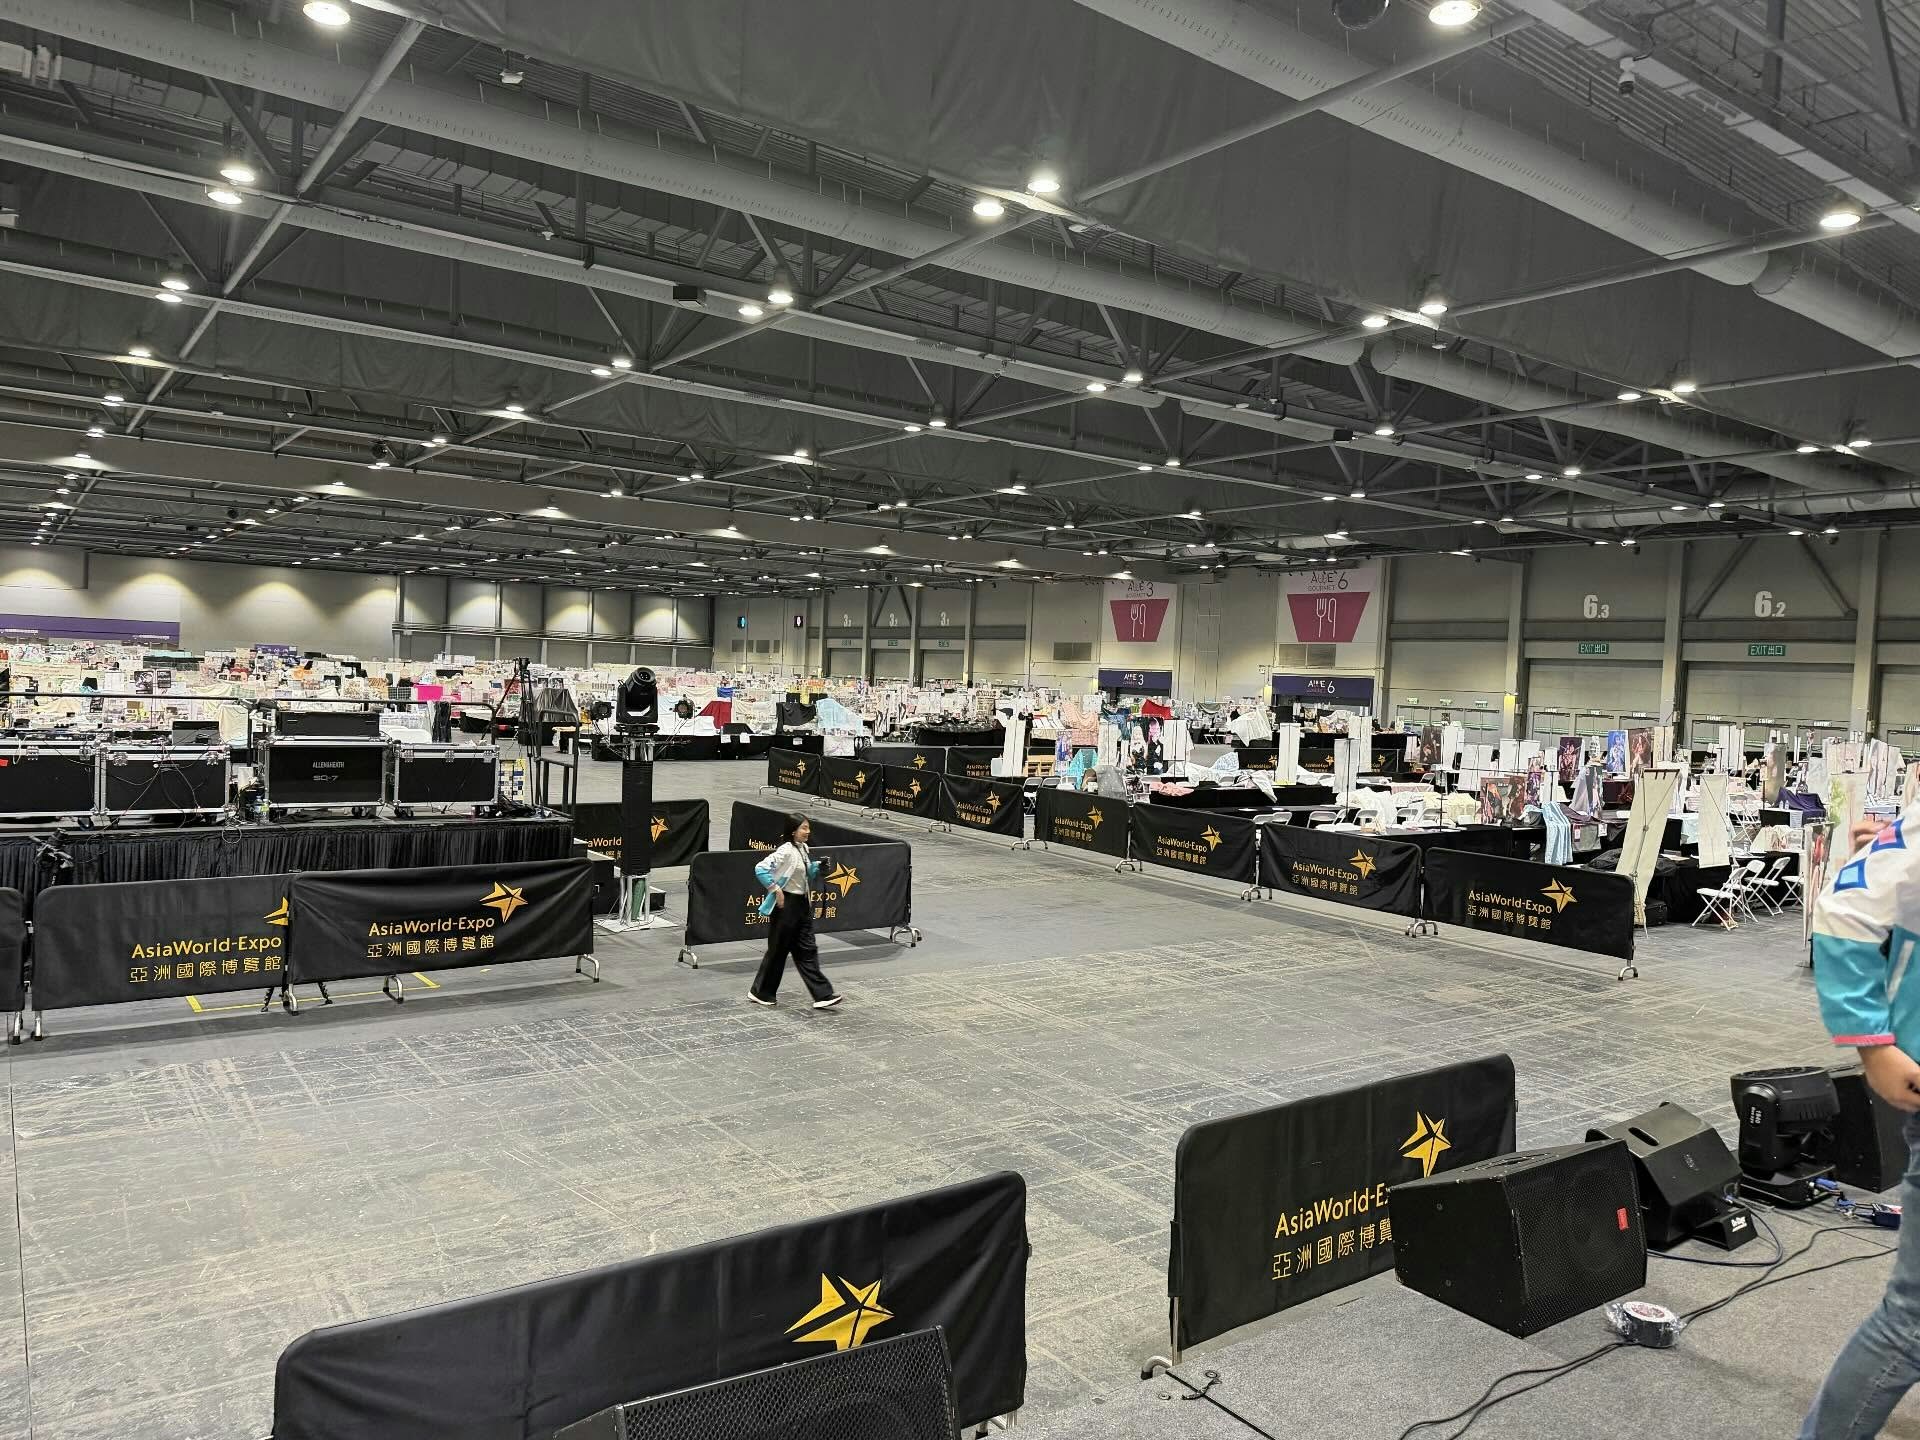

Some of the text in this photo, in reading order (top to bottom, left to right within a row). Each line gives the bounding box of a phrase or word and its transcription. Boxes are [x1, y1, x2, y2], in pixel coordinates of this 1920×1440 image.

[1146, 581, 1154, 597] 3
[1338, 571, 1349, 590] 6
[1583, 594, 1610, 619] 6.3
[1754, 590, 1786, 618] 6.2
[1580, 643, 1607, 653] EXIT 出口
[1750, 645, 1783, 655] EXIT 出口
[1138, 674, 1144, 686] 3
[1327, 680, 1336, 694] 6
[1054, 816, 1093, 831] AsiaWorld-Expo
[1157, 834, 1207, 853] AsiaWorld-Expo
[1292, 860, 1359, 882] AsiaWorld-Expo
[1468, 889, 1553, 915] AsiaWorld-Expo
[368, 915, 496, 938] AsiaWorld-Expo
[131, 935, 282, 960] AsiaWorld-Expo
[366, 934, 497, 959] 亞洲國際博覽館
[129, 955, 282, 983] 亞洲國際博覽館
[1274, 1182, 1389, 1239] AsiaWorld-E
[1271, 1216, 1393, 1281] 亞洲國際博覽
